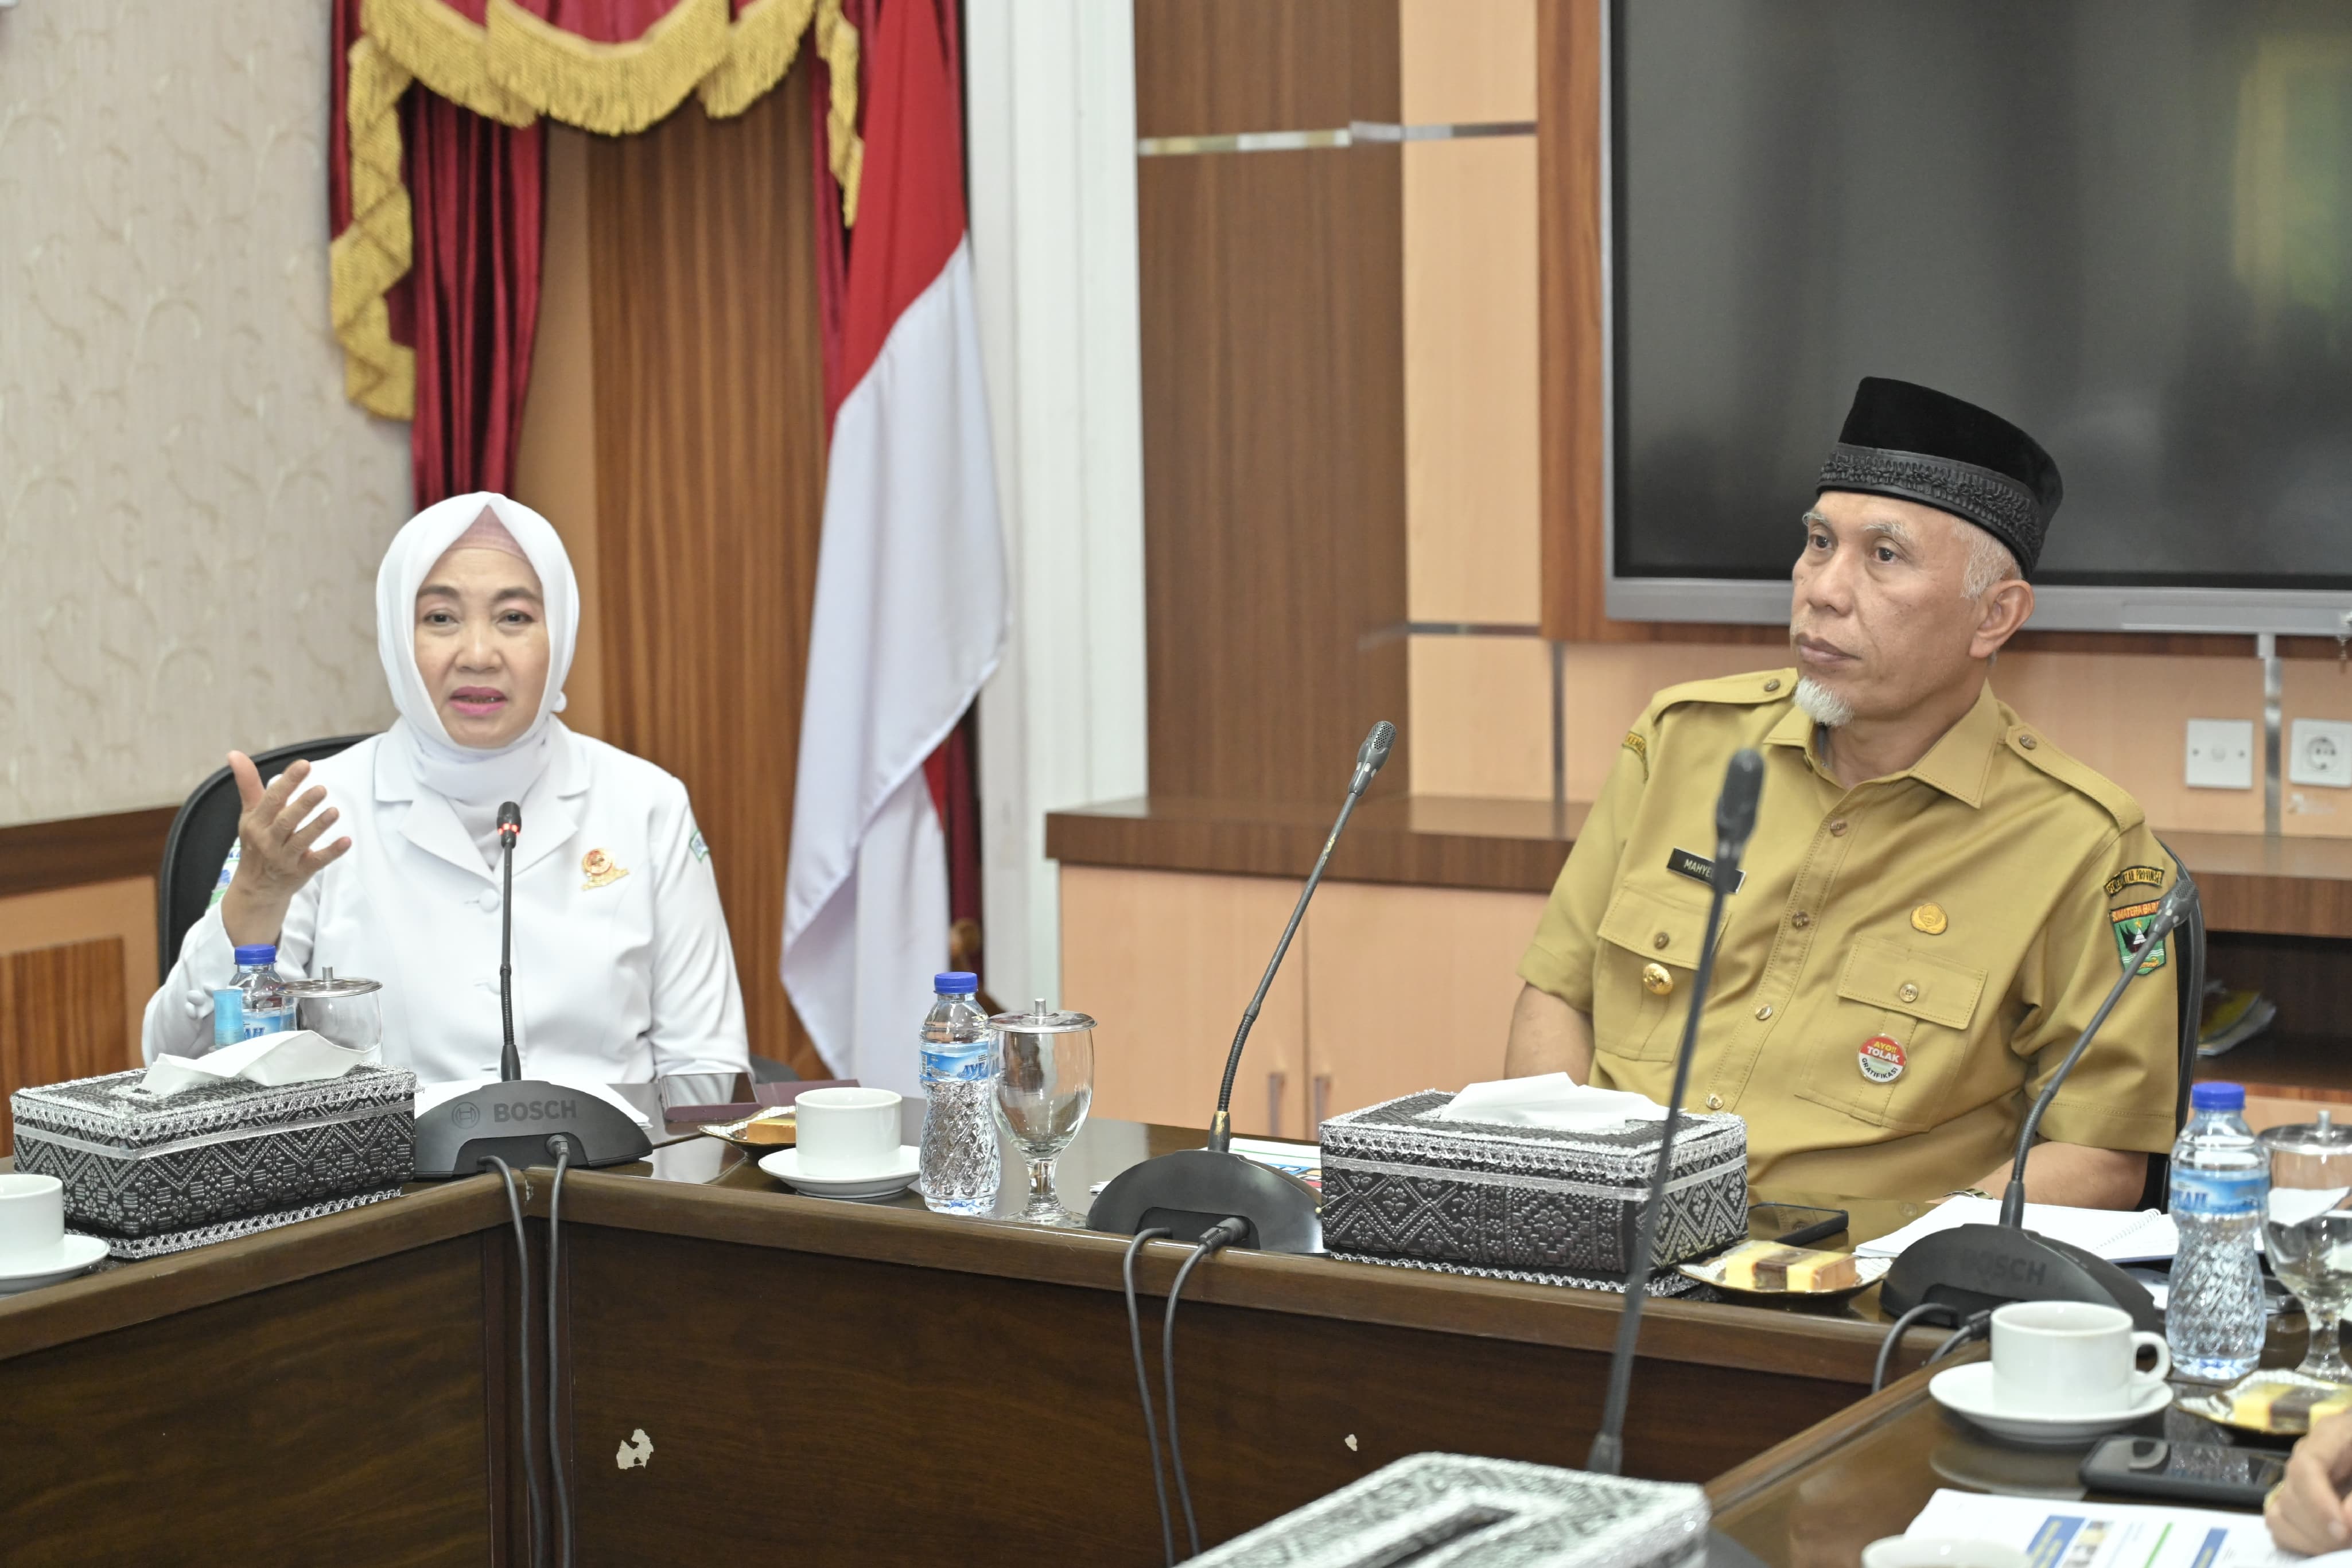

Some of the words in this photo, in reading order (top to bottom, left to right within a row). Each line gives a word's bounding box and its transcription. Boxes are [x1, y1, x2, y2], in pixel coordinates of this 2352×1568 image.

[2112, 905, 2143, 922] SUMATERA
[1867, 1045, 1900, 1063] TOLAK
[1873, 1041, 1897, 1053] AYO!!
[1861, 1057, 1898, 1079] GRATIFIKASI
[493, 1100, 577, 1122] BOSCH
[1961, 1248, 2047, 1286] BOSCH
